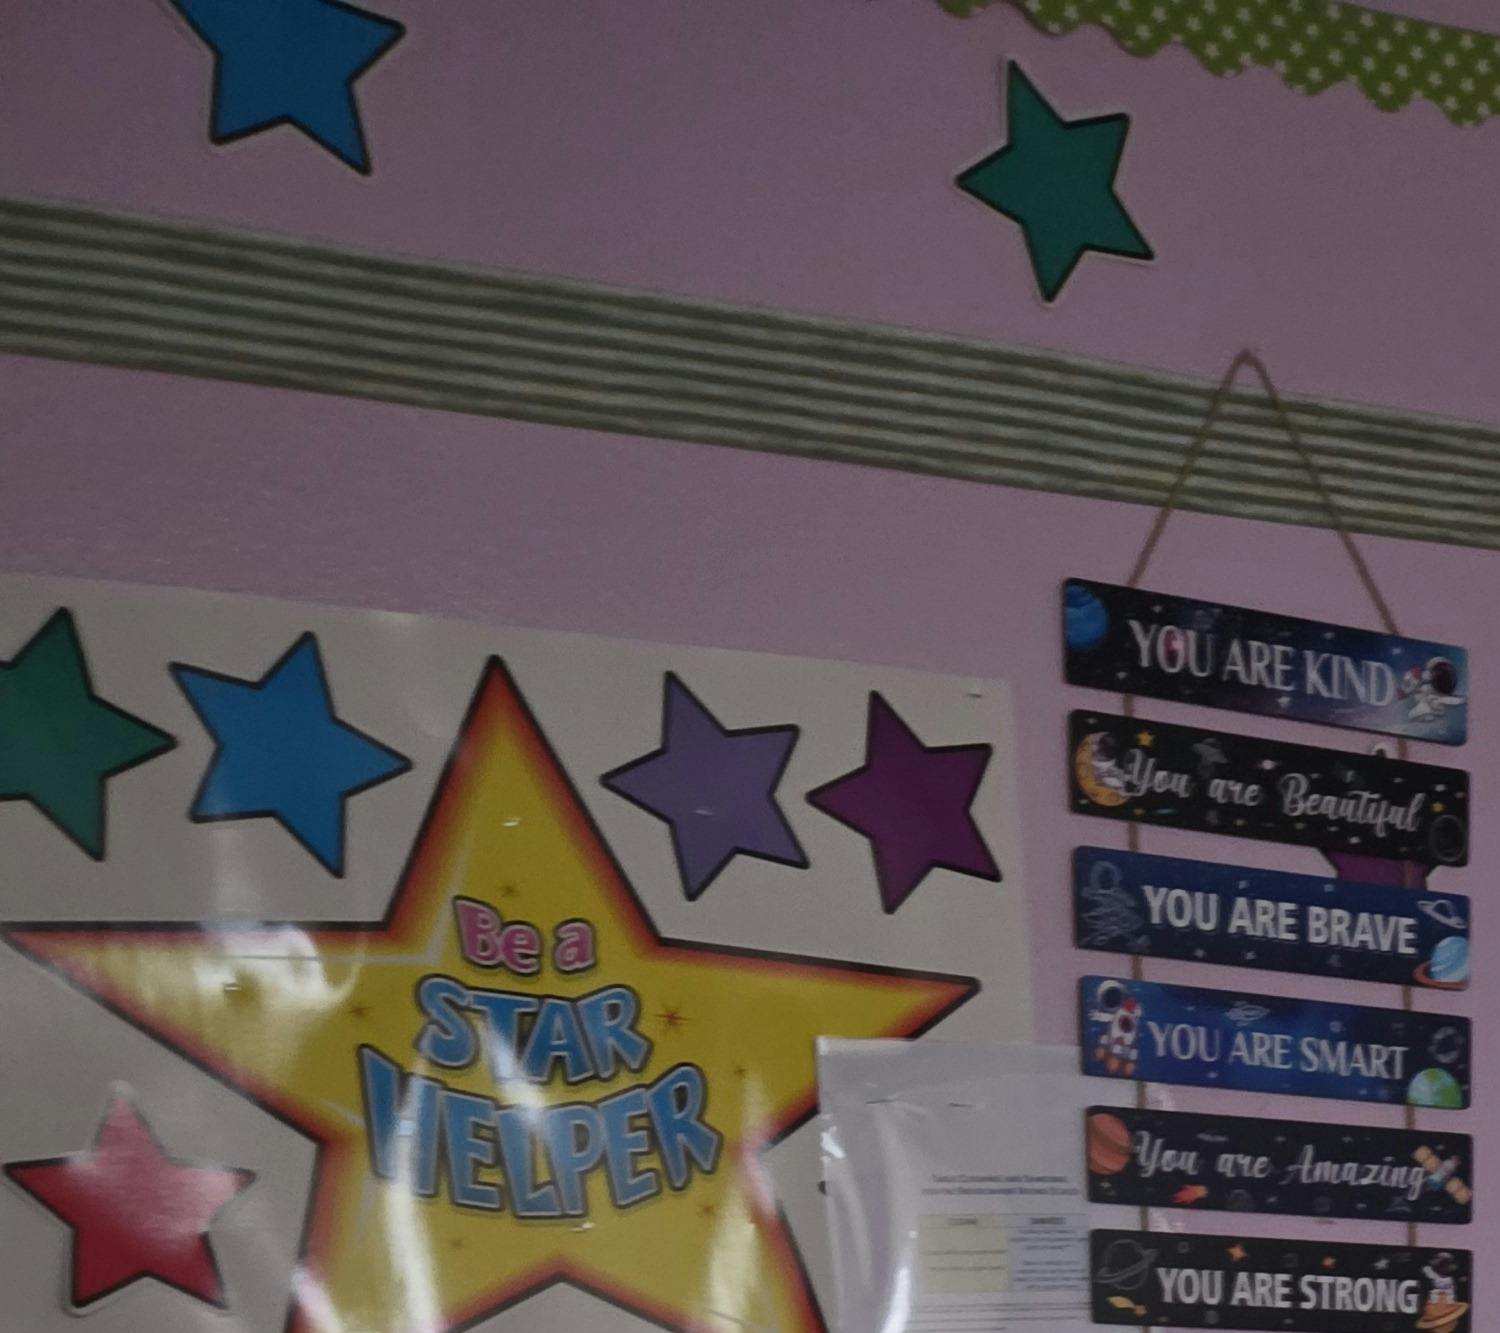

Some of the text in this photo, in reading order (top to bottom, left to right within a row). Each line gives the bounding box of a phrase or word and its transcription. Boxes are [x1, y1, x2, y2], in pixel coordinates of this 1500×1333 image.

[1127, 619, 1396, 707] YOU ARE KIND
[1121, 747, 1426, 836] You are Beautiful
[453, 895, 596, 976] Be a
[1142, 884, 1418, 955] YOU ARE BRAVE
[414, 973, 654, 1086] STAR
[1146, 1020, 1409, 1081] YOU ARE SMART
[357, 1044, 722, 1222] HELPER
[1131, 1130, 1427, 1201] You are Amazing
[1156, 1267, 1420, 1315] YOU ARE STRONG
